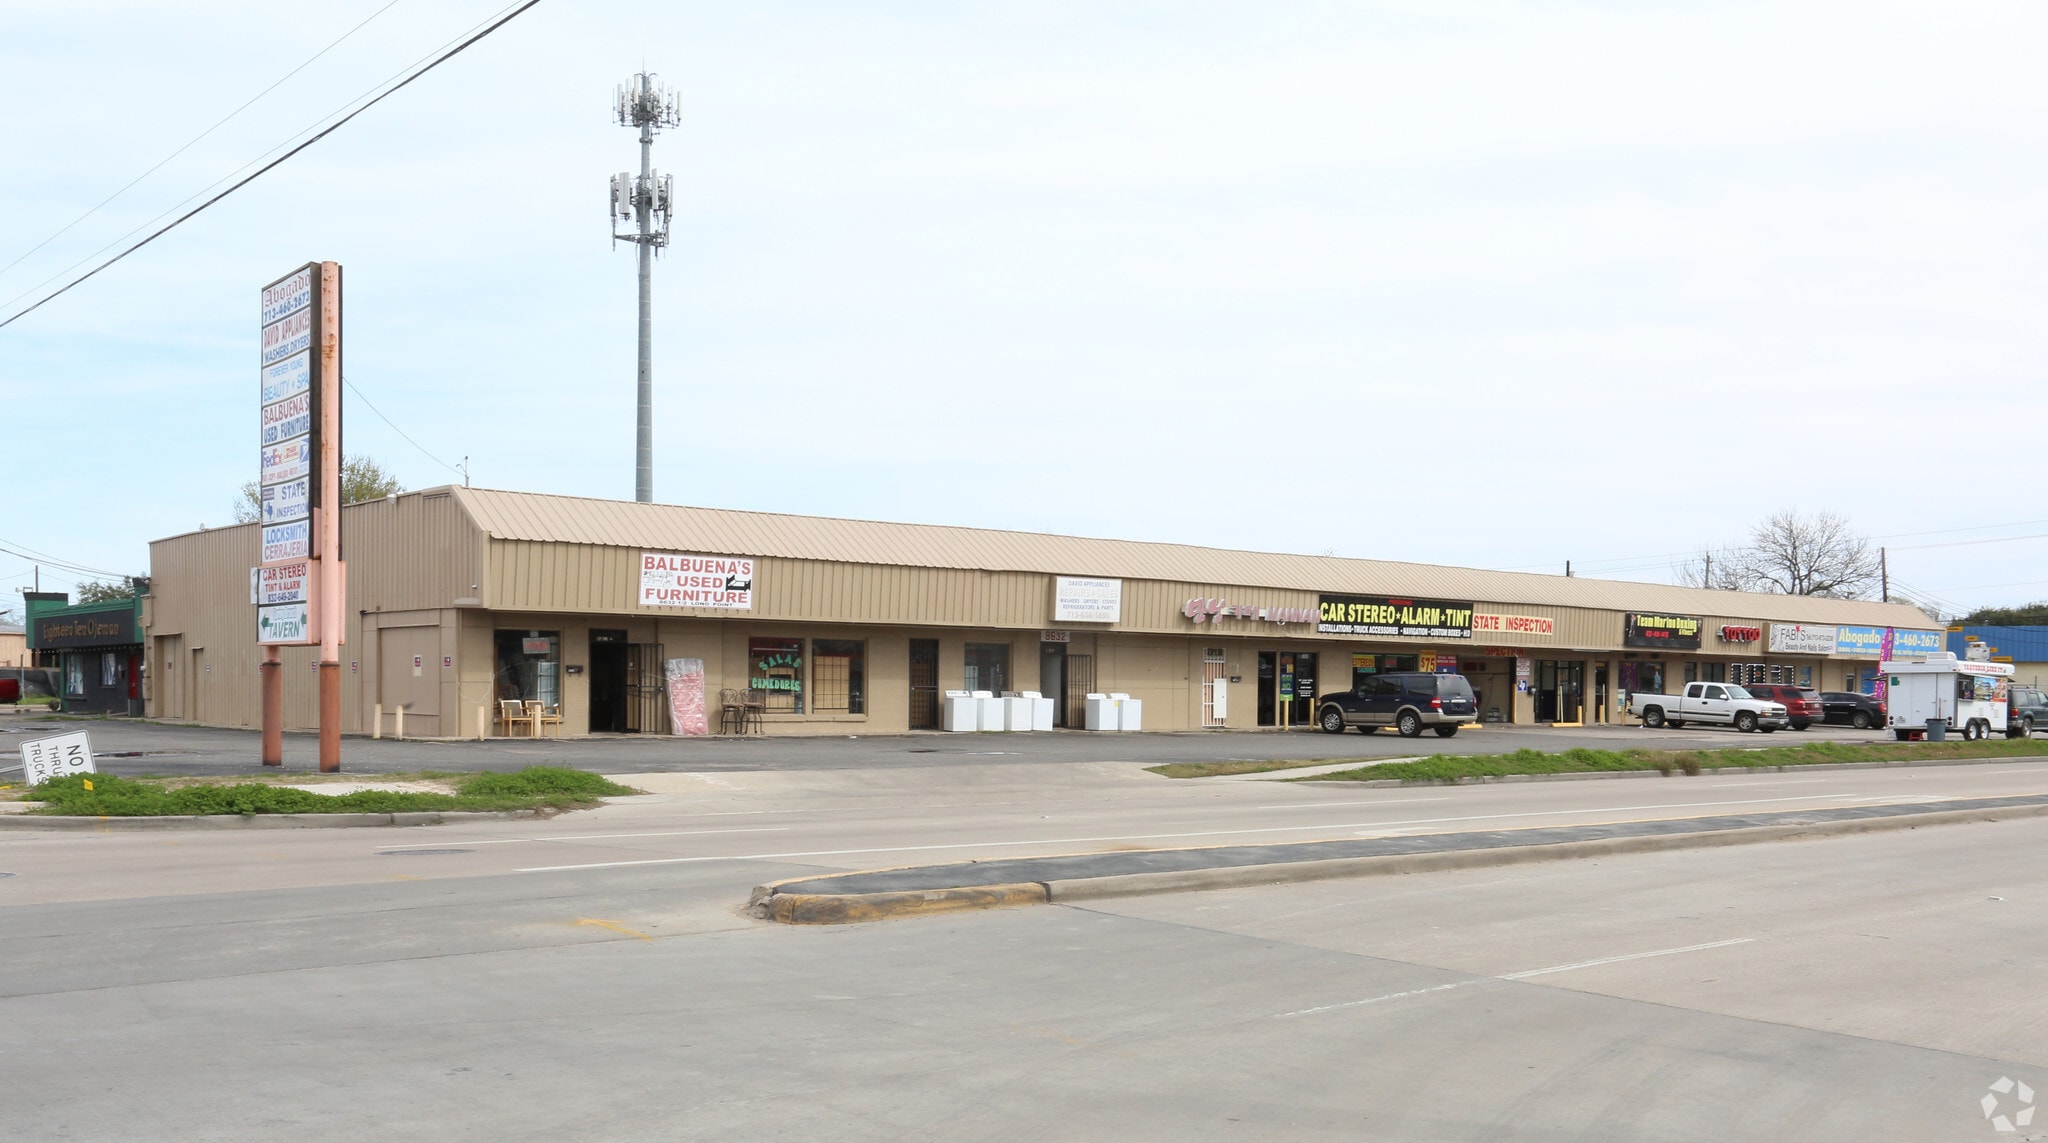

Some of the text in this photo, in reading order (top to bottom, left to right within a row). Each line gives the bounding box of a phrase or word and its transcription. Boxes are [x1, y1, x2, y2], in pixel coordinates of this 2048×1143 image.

[265, 274, 310, 307] Abogado
[264, 325, 279, 349] DAVID
[264, 370, 309, 402] BEAUTY SPA
[264, 394, 309, 425] BALBUENA'S
[264, 414, 309, 444] USED FURNITURE
[262, 448, 283, 468] FedEx
[282, 481, 305, 500] STATE
[266, 523, 307, 545] LOCKSMITH
[265, 540, 308, 560] CERRAJERIA
[263, 564, 307, 582] CAR STEREO
[644, 556, 751, 575] BALBUENA'S
[265, 583, 277, 593] TINT
[283, 580, 301, 591] ALARM
[677, 576, 723, 588] USED
[645, 588, 748, 604] FURNITURE
[1320, 602, 1472, 627] CAR STEREO ALARM TINT
[1473, 615, 1553, 633] STATE INSPECTION
[269, 621, 300, 638] TAVERN
[1045, 630, 1066, 641] 8632
[1839, 628, 1880, 646] Abogado
[1894, 633, 1940, 647] 3-460-2673
[758, 653, 802, 670] SALAS
[1421, 657, 1435, 672] $75
[752, 677, 801, 691] COMEDORES
[30, 743, 50, 786] TRUCKS
[47, 745, 65, 777] THRU
[66, 744, 84, 767] NO
